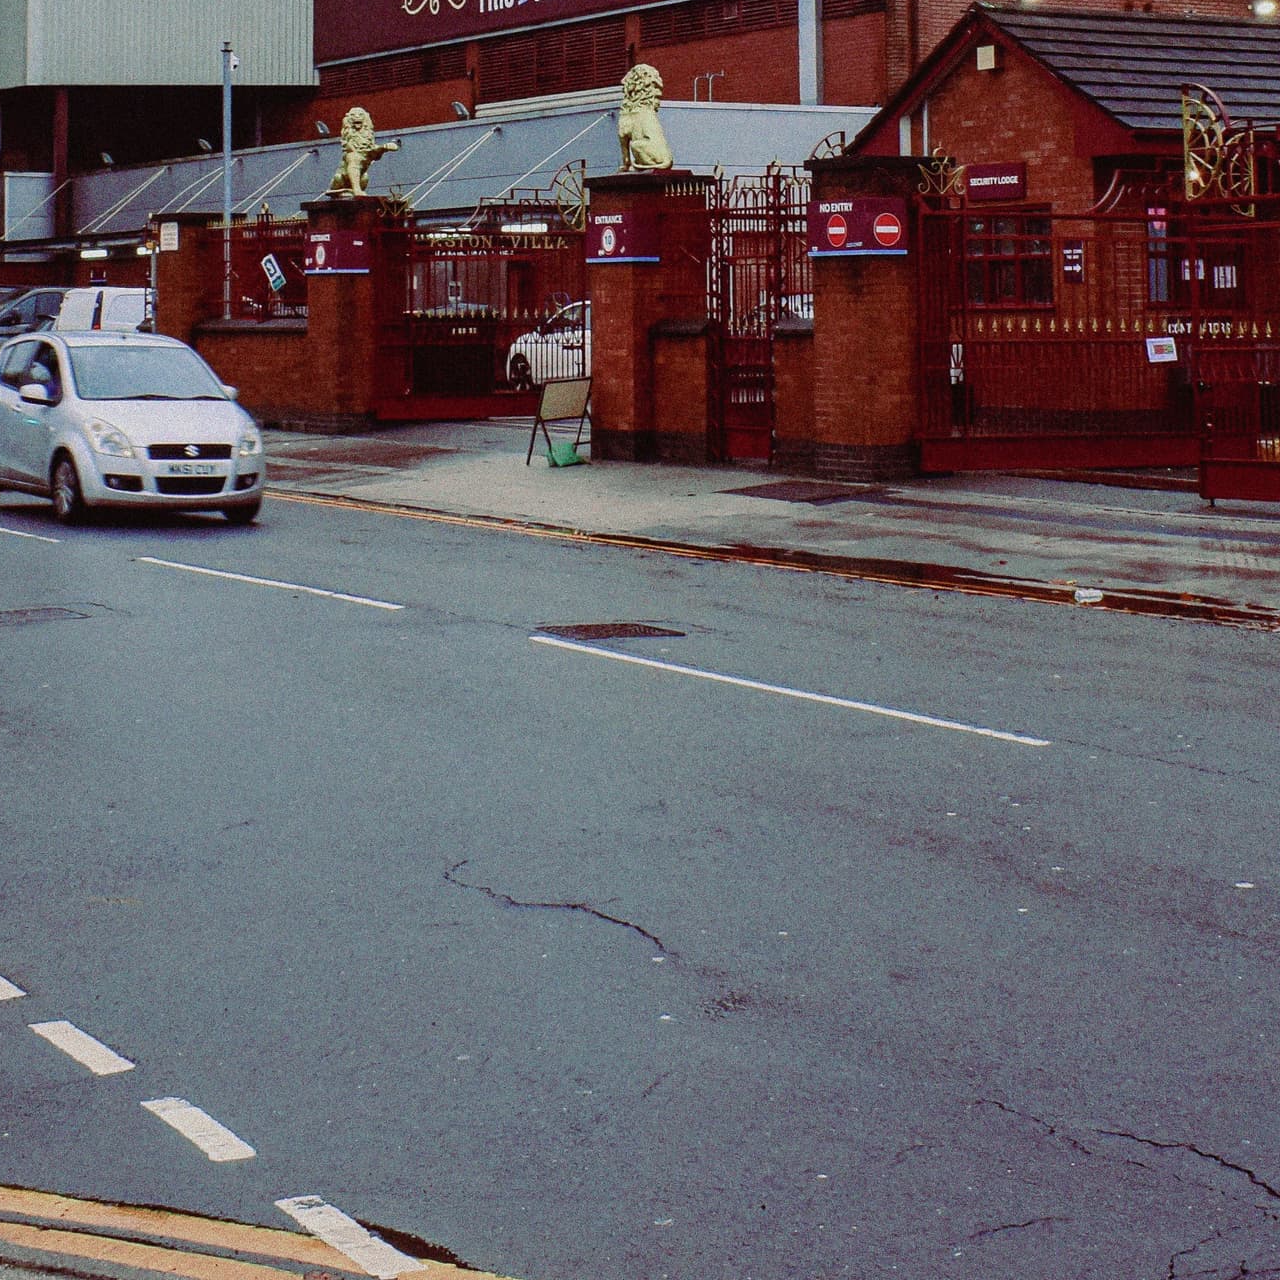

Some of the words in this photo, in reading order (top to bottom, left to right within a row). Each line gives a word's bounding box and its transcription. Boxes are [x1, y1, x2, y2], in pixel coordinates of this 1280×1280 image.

[969, 177, 997, 186] SECURITY
[998, 175, 1019, 185] LODGE
[819, 203, 830, 213] NO
[831, 202, 853, 213] ENTRY
[594, 214, 623, 225] ENTRANCE
[511, 235, 569, 249] VILLA
